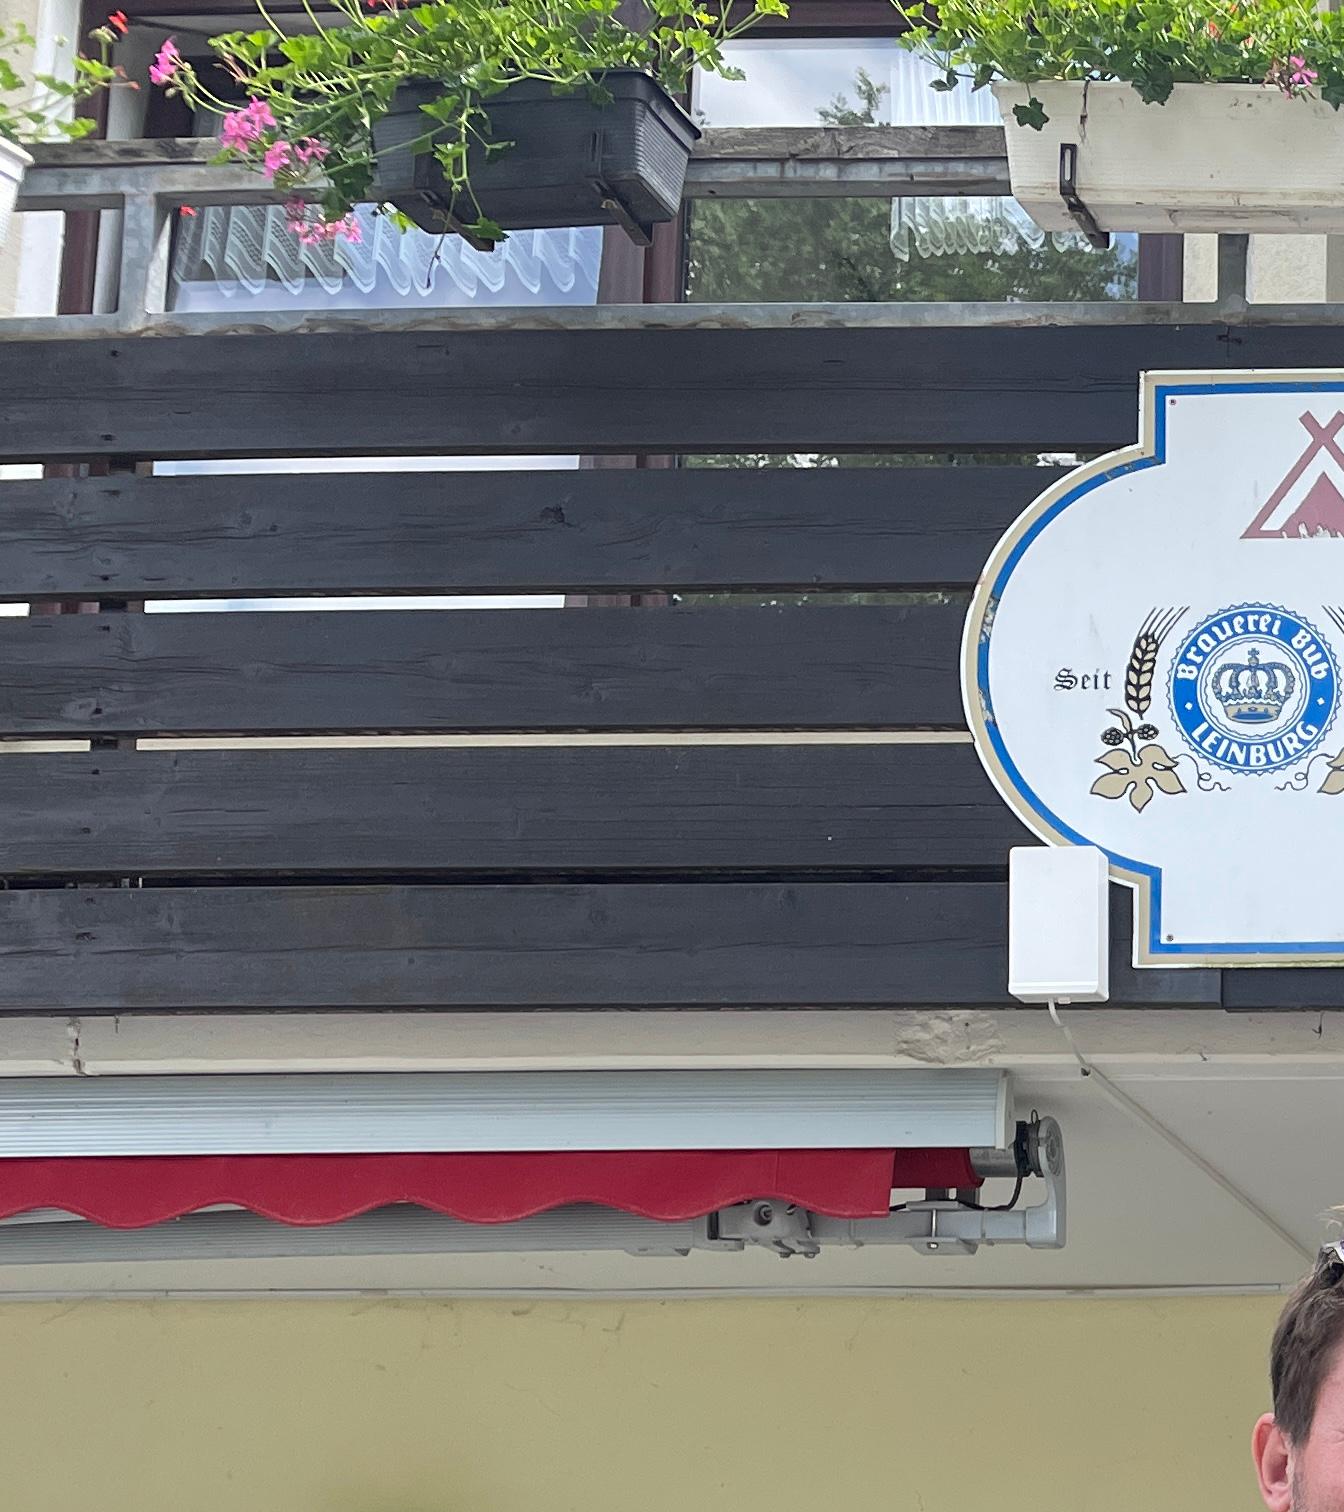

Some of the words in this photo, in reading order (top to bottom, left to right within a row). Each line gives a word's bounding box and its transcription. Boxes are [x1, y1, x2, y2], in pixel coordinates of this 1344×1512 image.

[1176, 611, 1282, 680] Brauerei
[1291, 628, 1330, 681] Bub
[1054, 668, 1112, 692] Seit
[1190, 720, 1319, 766] LEINBURG
